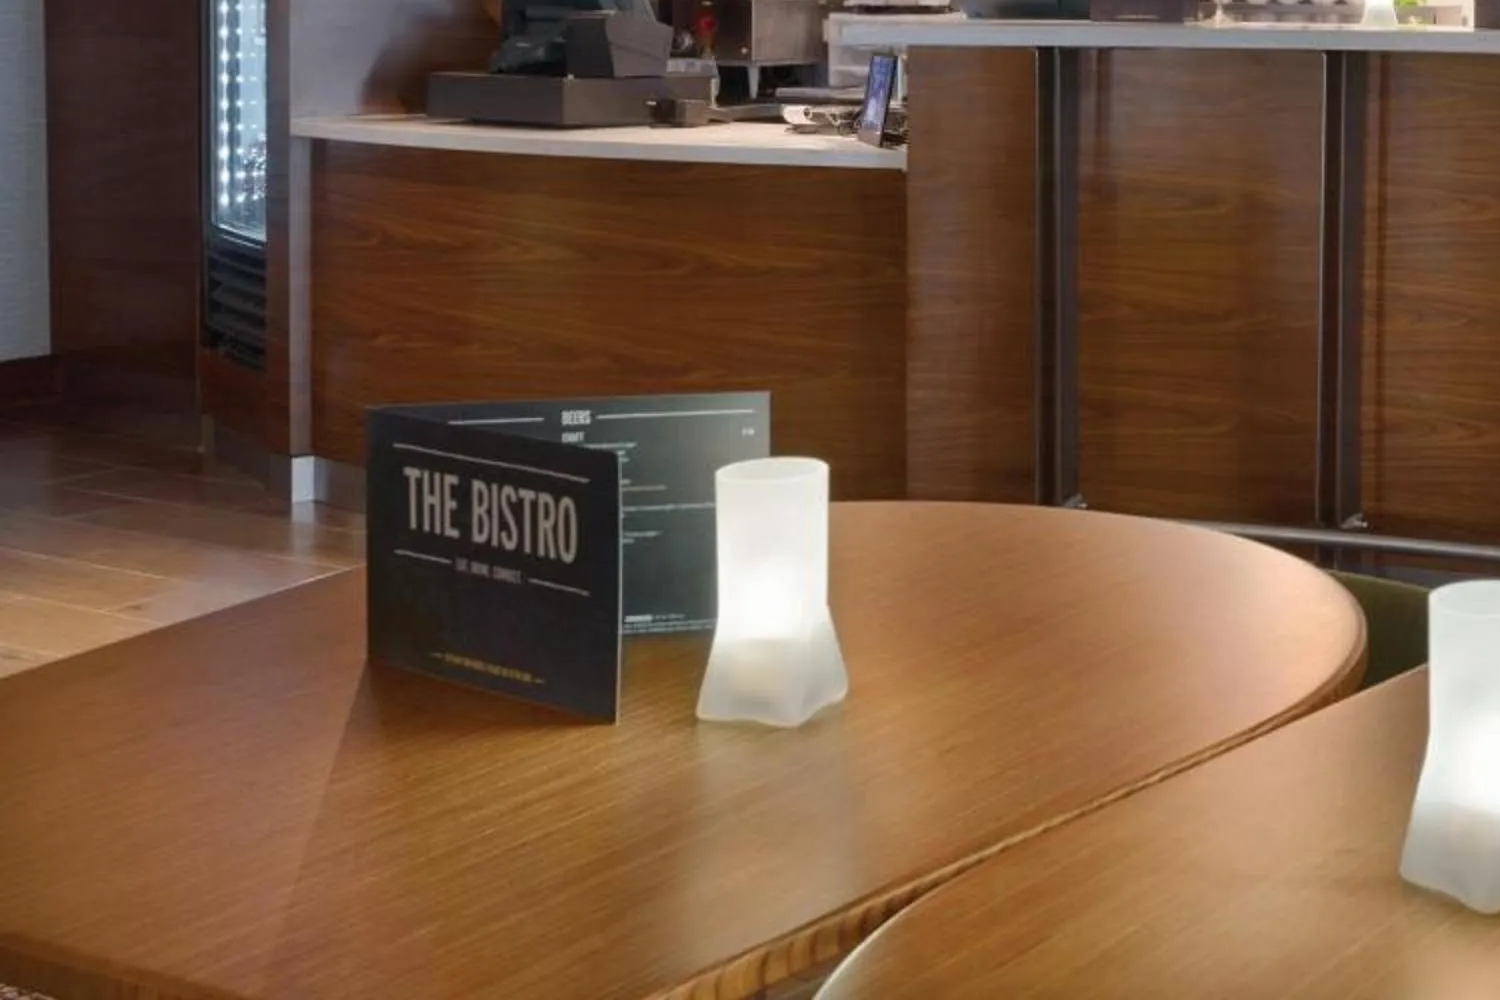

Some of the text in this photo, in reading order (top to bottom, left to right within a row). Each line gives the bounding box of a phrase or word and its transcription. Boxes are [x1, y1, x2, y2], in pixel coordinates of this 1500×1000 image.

[561, 410, 591, 426] BEERS
[403, 466, 460, 540] THE
[470, 478, 579, 564] BISTRO
